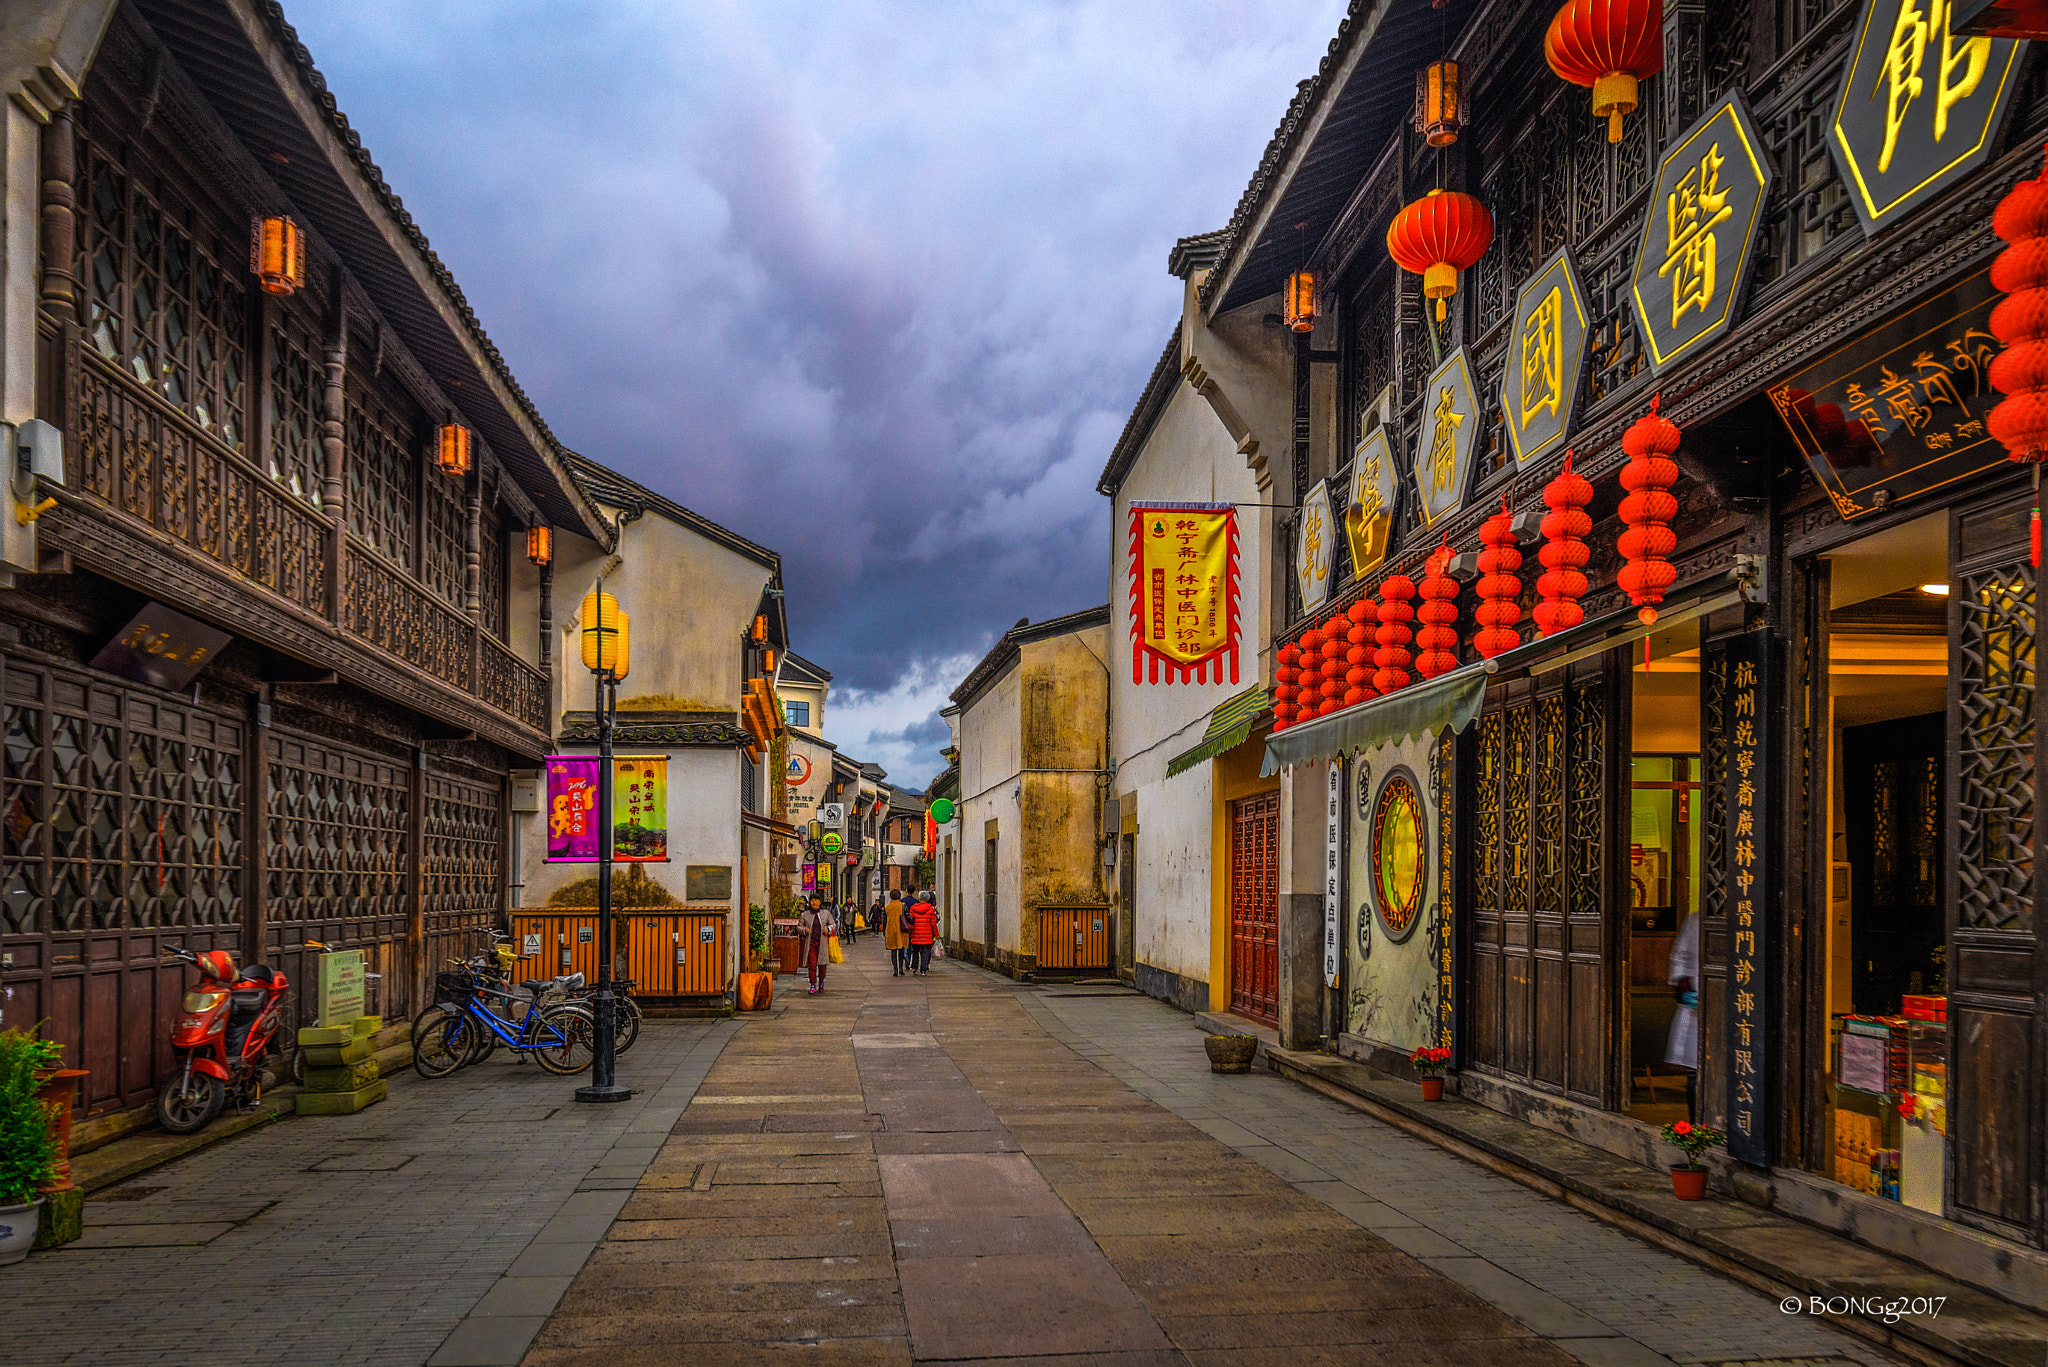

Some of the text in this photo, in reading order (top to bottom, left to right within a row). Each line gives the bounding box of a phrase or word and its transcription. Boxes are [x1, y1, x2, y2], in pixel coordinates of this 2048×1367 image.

[1174, 519, 1201, 654] 乾宁斋广林中医门诊部
[1326, 770, 1338, 975] 省市医保定点单位
